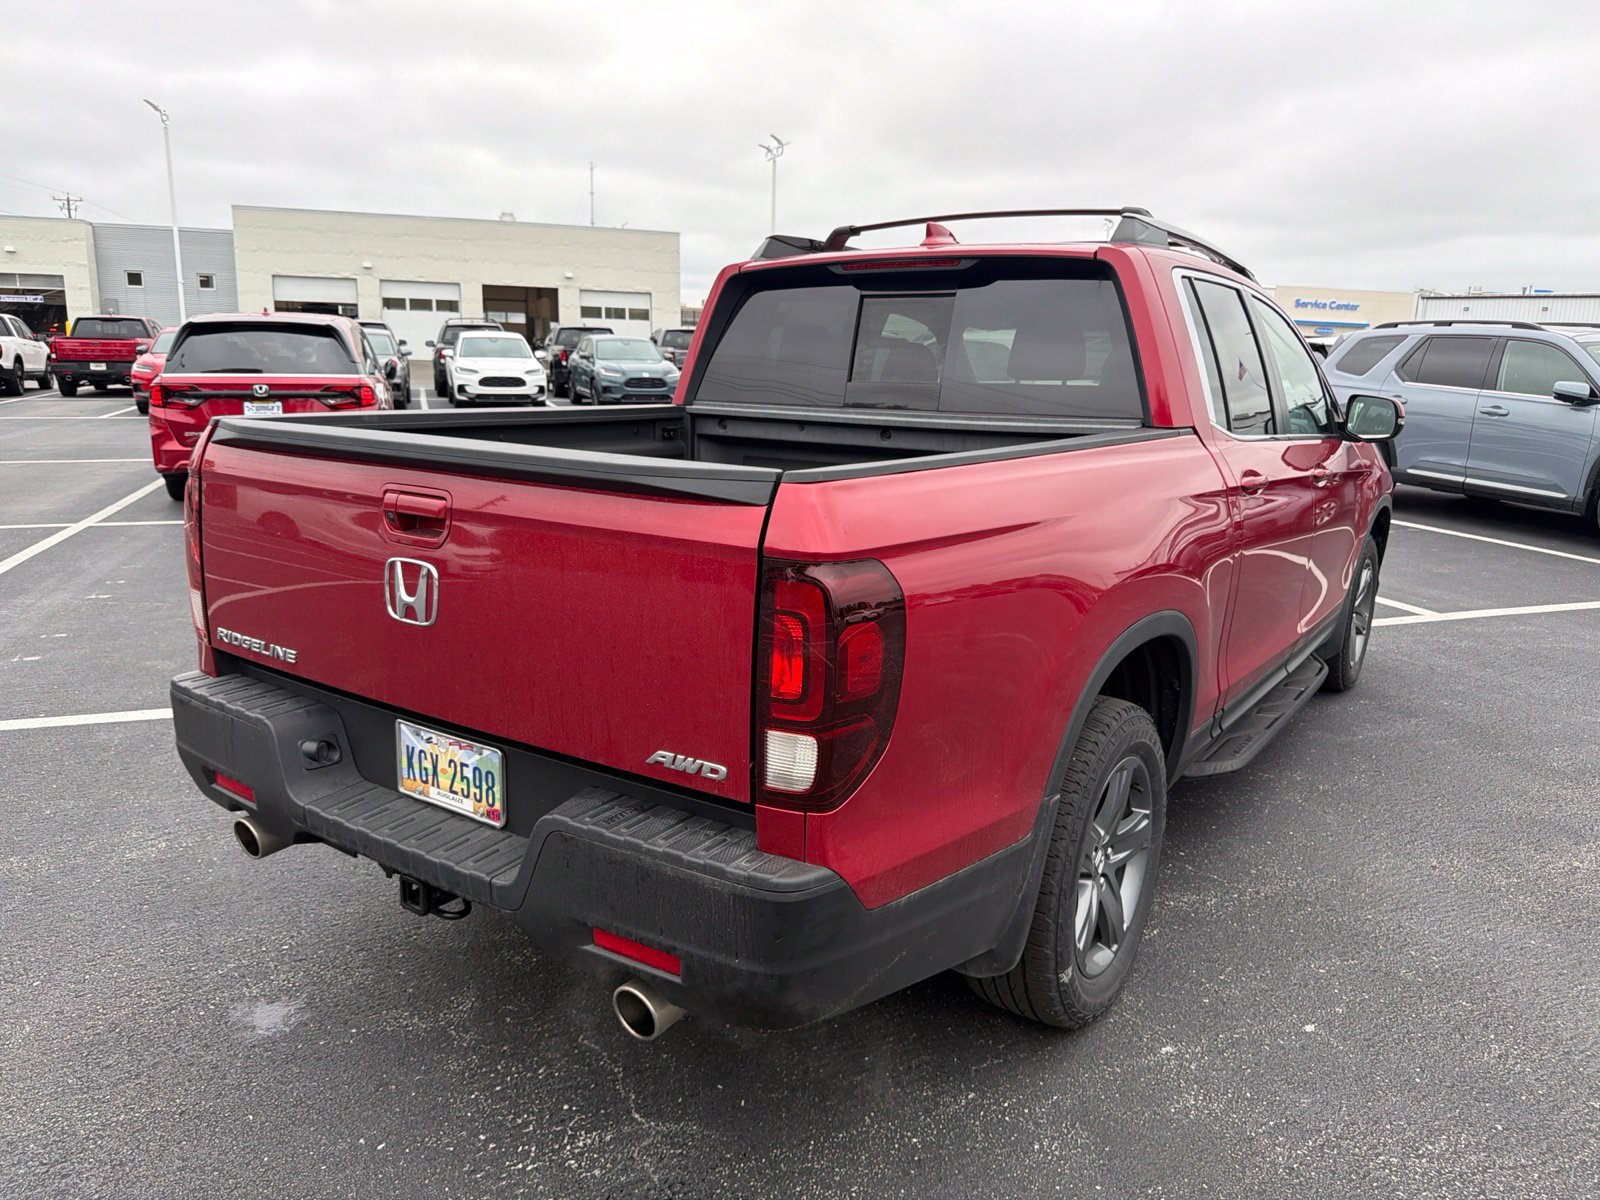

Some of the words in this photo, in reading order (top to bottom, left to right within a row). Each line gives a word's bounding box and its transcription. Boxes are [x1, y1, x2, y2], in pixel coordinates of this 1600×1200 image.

[1295, 299, 1327, 309] Service
[1329, 301, 1360, 311] Center
[217, 627, 298, 664] RIDGELINE
[406, 744, 440, 790] KGX
[448, 759, 496, 808] 2598
[645, 750, 728, 781] AWD
